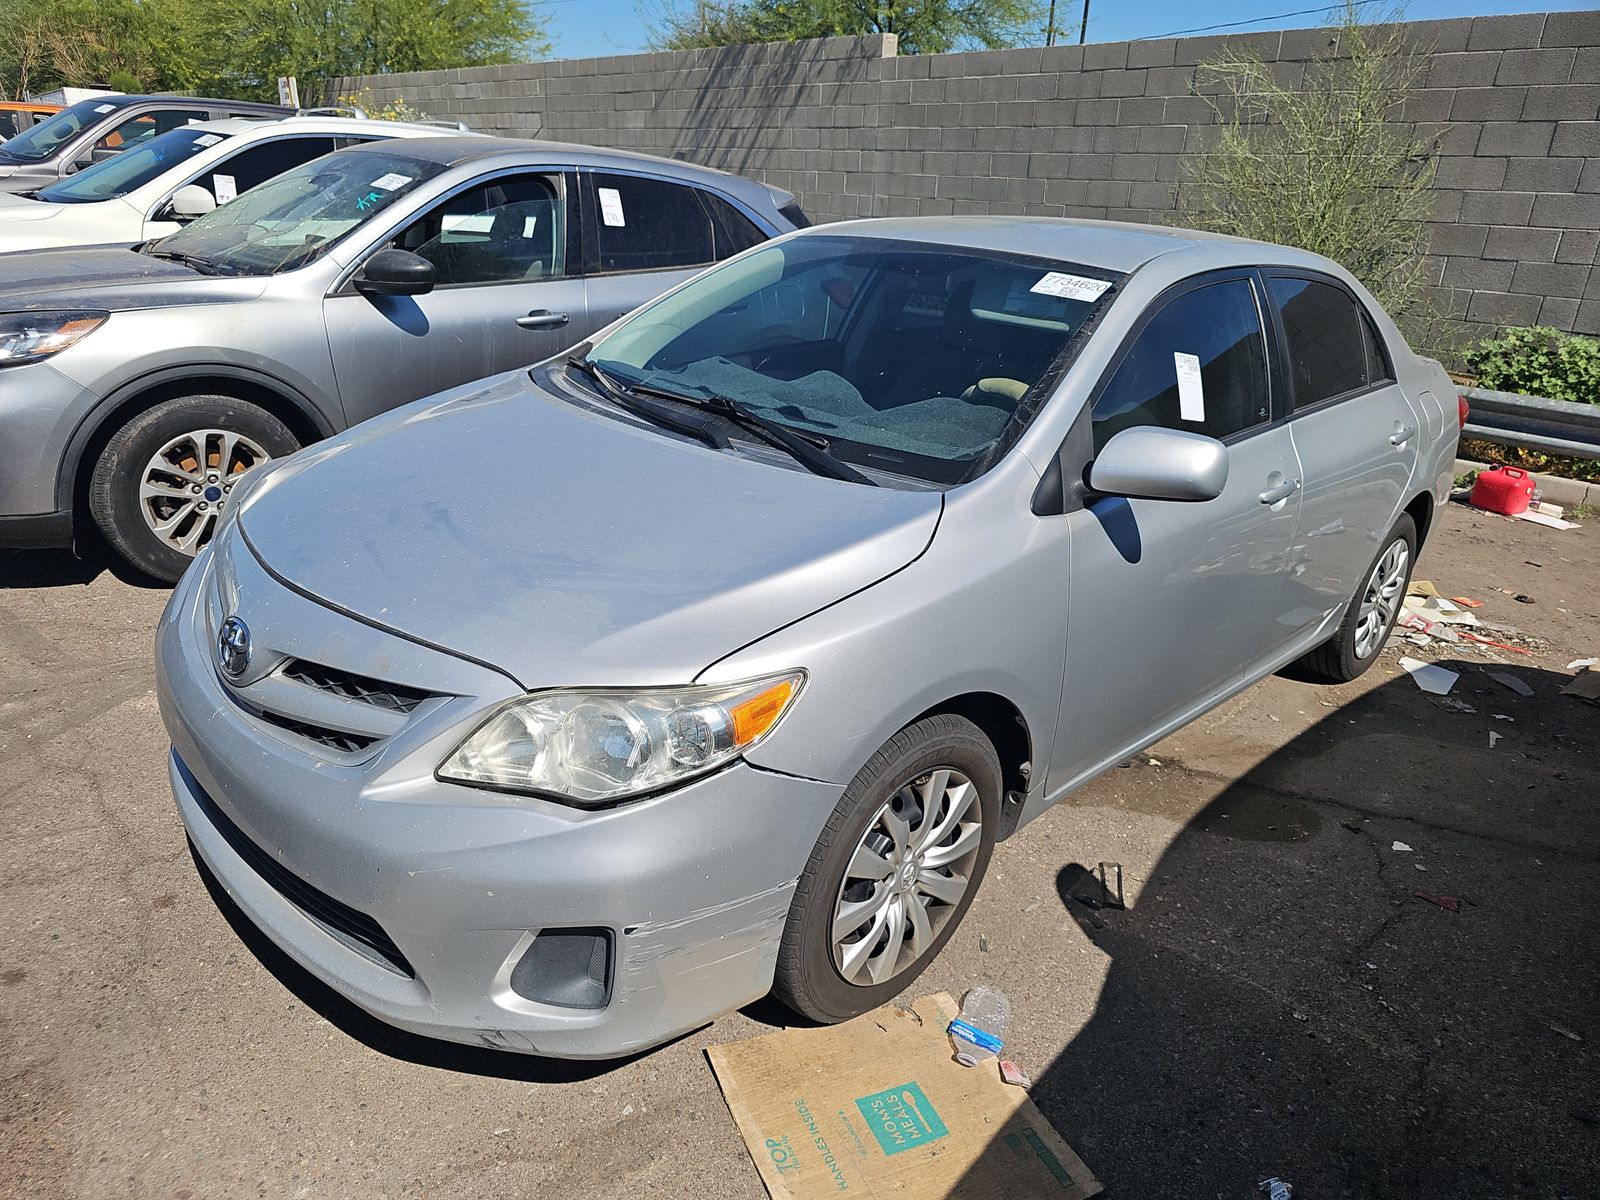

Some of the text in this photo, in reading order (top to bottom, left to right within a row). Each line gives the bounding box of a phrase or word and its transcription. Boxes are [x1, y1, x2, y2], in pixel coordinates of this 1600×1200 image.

[1045, 275, 1107, 292] 7734620
[871, 1100, 906, 1144] MOM'S
[887, 1094, 922, 1139] MEALS
[765, 1139, 793, 1174] TOP
[794, 1099, 848, 1191] HANDLES INSIDE
